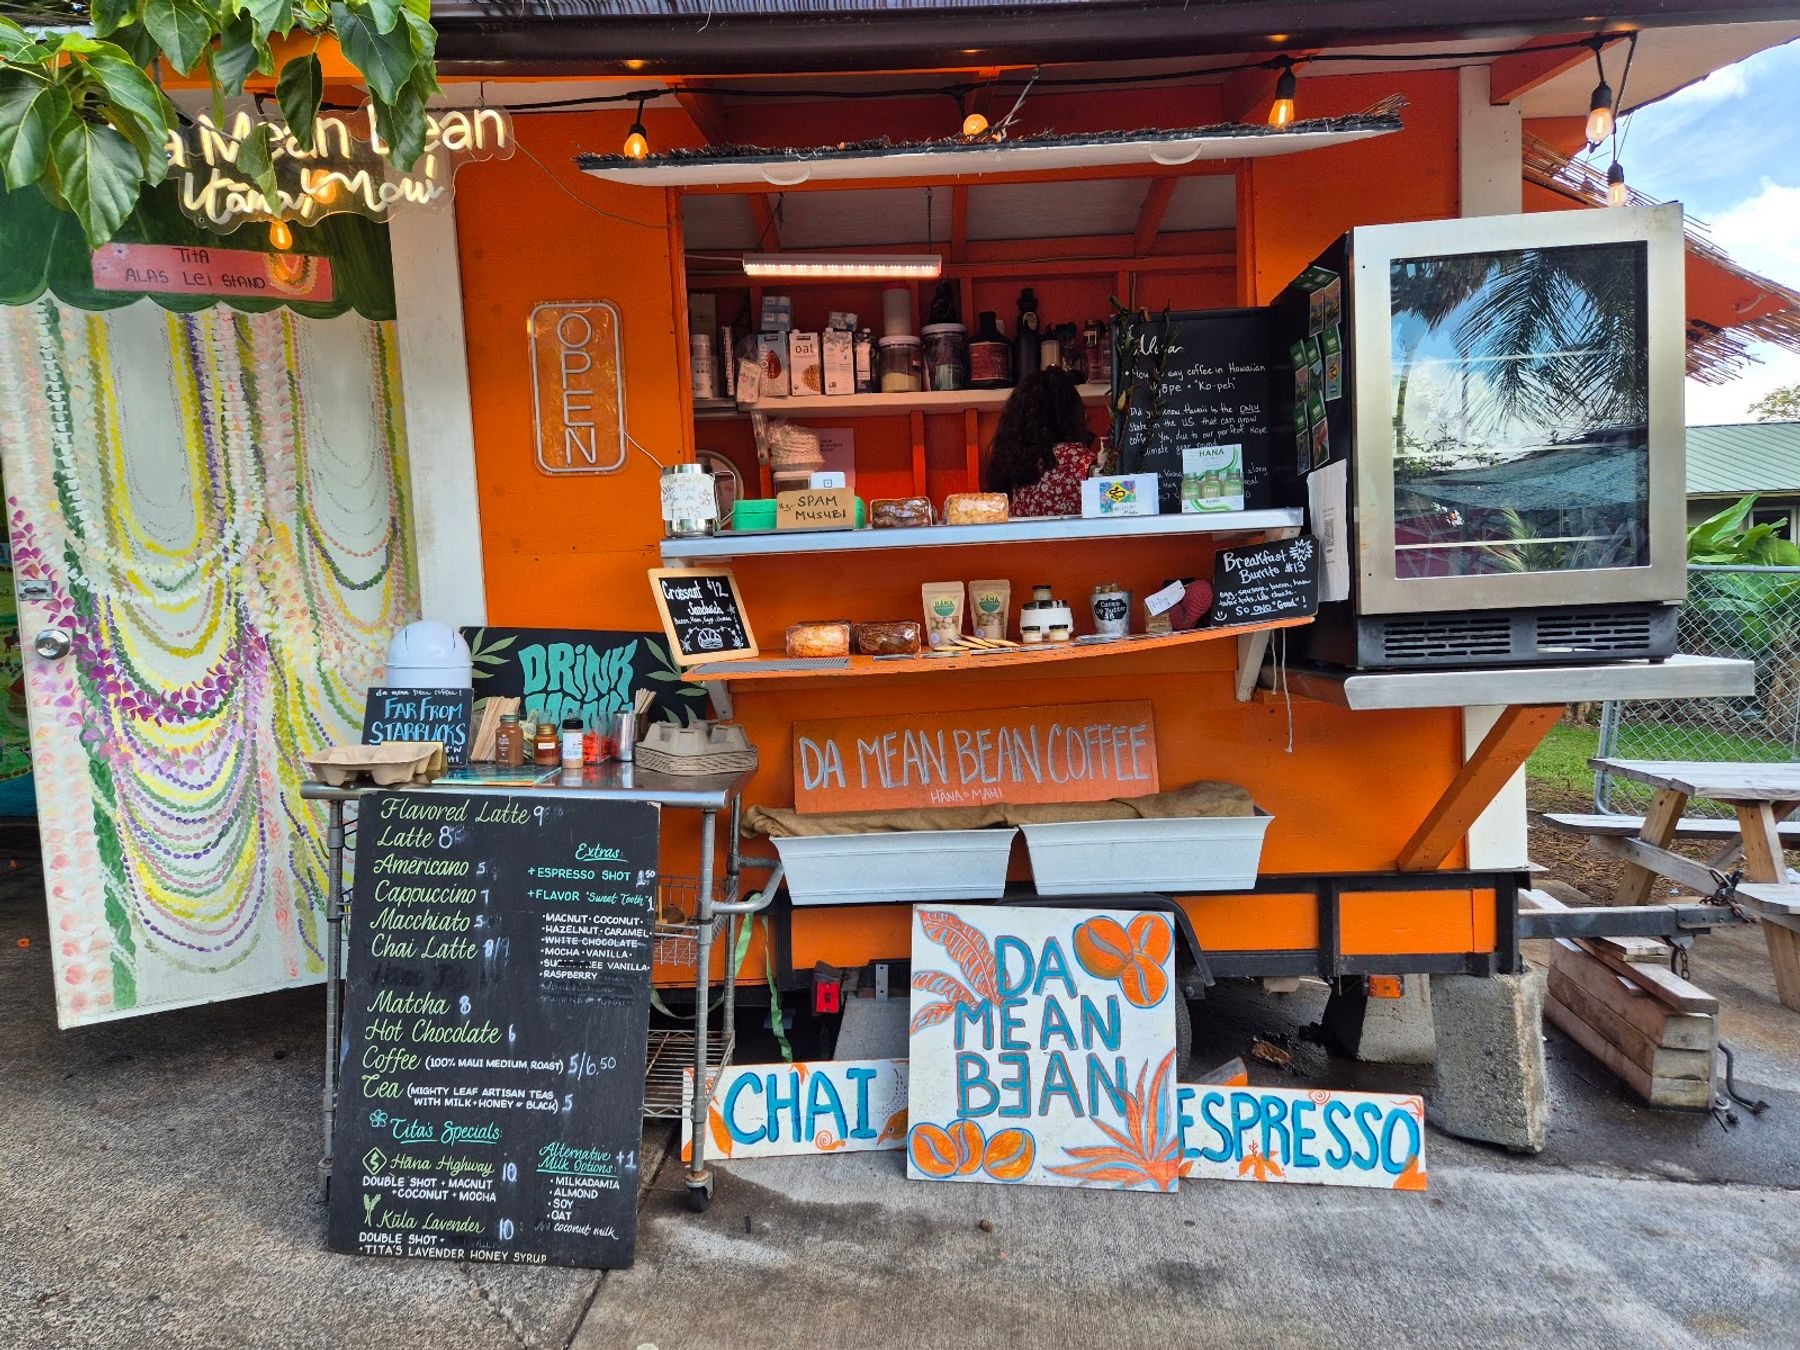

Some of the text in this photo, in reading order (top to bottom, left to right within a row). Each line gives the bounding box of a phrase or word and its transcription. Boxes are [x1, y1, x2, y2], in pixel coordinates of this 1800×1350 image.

[367, 103, 506, 155] ean
[795, 343, 814, 355] oat
[1187, 363, 1213, 376] coffee
[1228, 362, 1266, 374] Hawaiian
[556, 313, 596, 465] OPEN
[797, 495, 838, 508] SPAM
[795, 509, 847, 521] MUSUBI
[1223, 549, 1288, 573] Breakfast
[1239, 566, 1281, 584] Burrito
[384, 696, 463, 721] FAR FROM
[799, 722, 1150, 791] DA MEAN BEAN COFFEE
[380, 797, 468, 822] Flavored
[474, 801, 531, 825] Latte
[376, 825, 435, 849] Latte
[373, 852, 470, 876] Americano
[601, 870, 632, 881] SHOT
[374, 879, 477, 908] Cappuccino
[369, 907, 471, 932] Macchiato
[545, 913, 588, 924] MACNUT
[545, 925, 599, 935] HAZELNUT
[371, 933, 479, 960] Chai Latte
[545, 936, 638, 948] WHITE CHOCOLATE
[544, 948, 628, 959] MOCHA VANILLA
[543, 970, 598, 980] RASPBERRY
[607, 962, 647, 972] VANILLA
[994, 934, 1079, 999] DA
[366, 989, 450, 1015] Matcha
[364, 1018, 403, 1042] Hot
[411, 1018, 502, 1044] Chocolate
[953, 994, 1121, 1051] MEAN
[362, 1045, 422, 1073] Coffee
[425, 1055, 456, 1070] (100%
[458, 1058, 484, 1068] MAUI
[486, 1059, 528, 1070] MEDIUM
[530, 1059, 564, 1072] ROAST)
[361, 1073, 554, 1100] Tea (MIGHTY LEAF ARTISAN TEAS
[956, 1050, 1128, 1118] BEAN
[414, 1097, 442, 1107] WITH
[526, 1100, 558, 1114] BLACK)
[723, 1067, 878, 1145] CHAI
[390, 1118, 434, 1139] Tita's
[1177, 1087, 1420, 1175] ESPRESSO
[538, 1155, 569, 1171] Milk
[539, 1141, 637, 1169] Alternative +1
[436, 1155, 495, 1177] Highway
[502, 1162, 518, 1182] 10
[362, 1175, 493, 1190] DOUBLE SHOT MACNUT
[553, 1187, 598, 1199] ALMOND
[555, 1176, 620, 1190] MILKADAMIA
[459, 1191, 497, 1202] MOCHA
[553, 1198, 574, 1209] SOY
[421, 1212, 486, 1234] Lavender
[499, 1218, 514, 1240] 10
[551, 1211, 573, 1221] OAT
[359, 1231, 437, 1244] DOUBLE SHOT
[554, 1222, 591, 1236] coconut
[593, 1225, 620, 1240] milk
[408, 1247, 465, 1259] LAVENDER
[470, 1250, 508, 1262] HONEY
[513, 1252, 547, 1264] SYRUP
